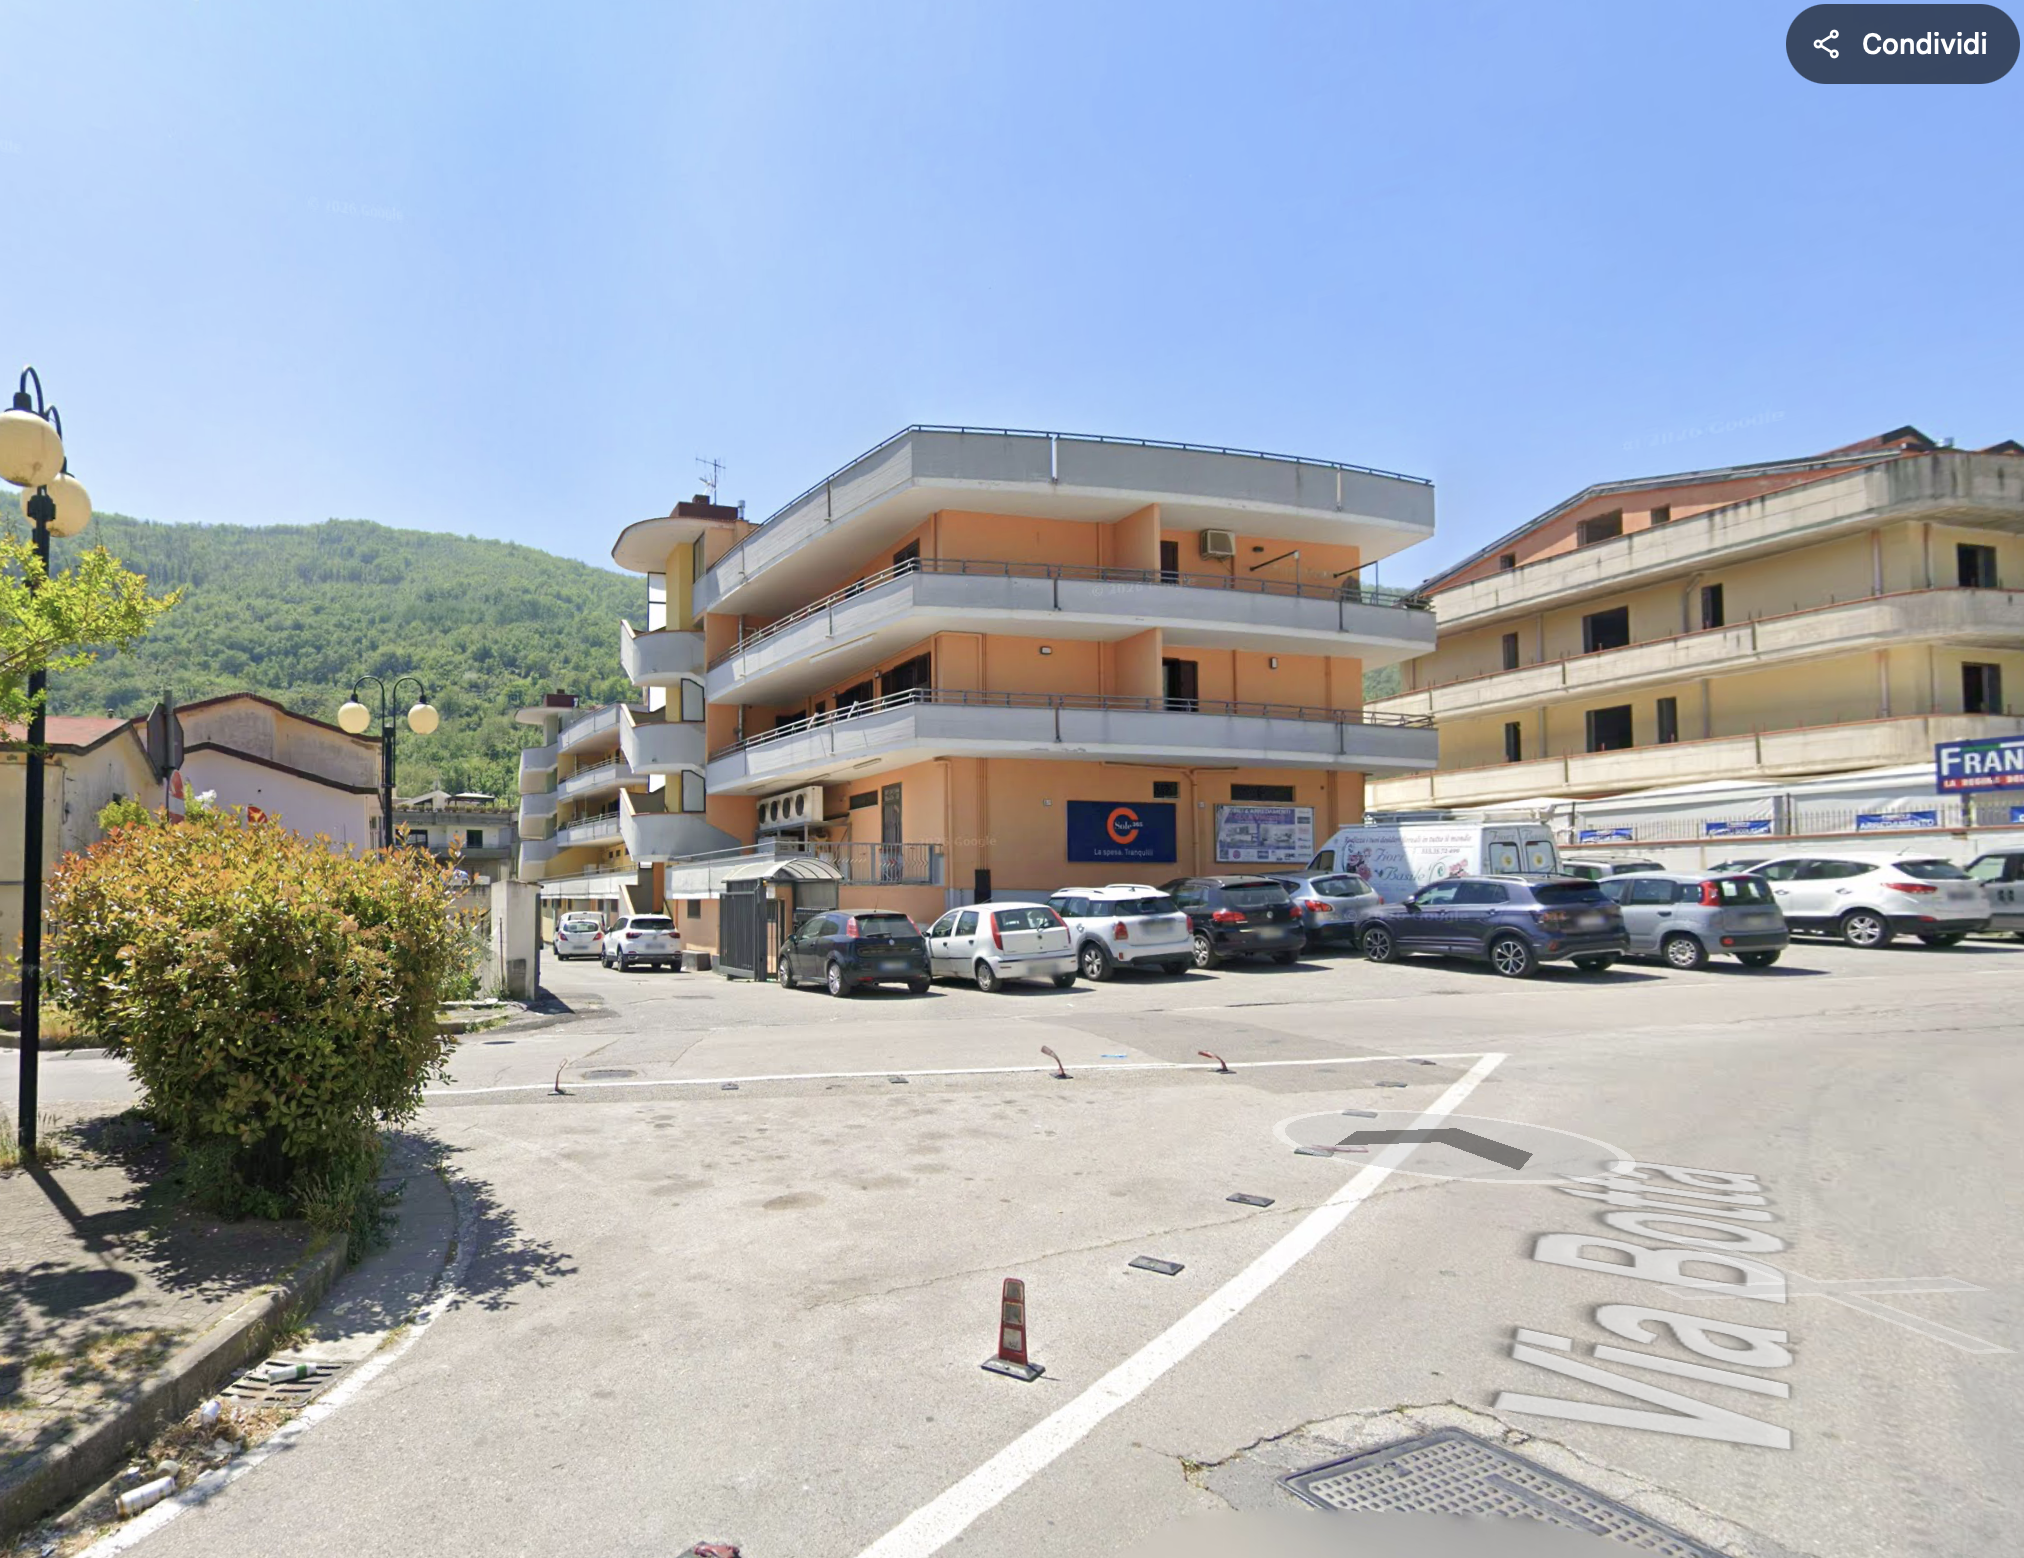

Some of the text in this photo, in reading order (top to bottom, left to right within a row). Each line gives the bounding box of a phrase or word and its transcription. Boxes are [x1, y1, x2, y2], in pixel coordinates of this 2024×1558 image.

[1940, 747, 2024, 776] FRAN
[1943, 779, 1956, 788] LA
[1450, 833, 1472, 842] mondo
[1094, 848, 1102, 856] La
[1102, 849, 1123, 857] spesa.
[1373, 847, 1405, 862] Fiori
[1382, 866, 1425, 881] Basile
